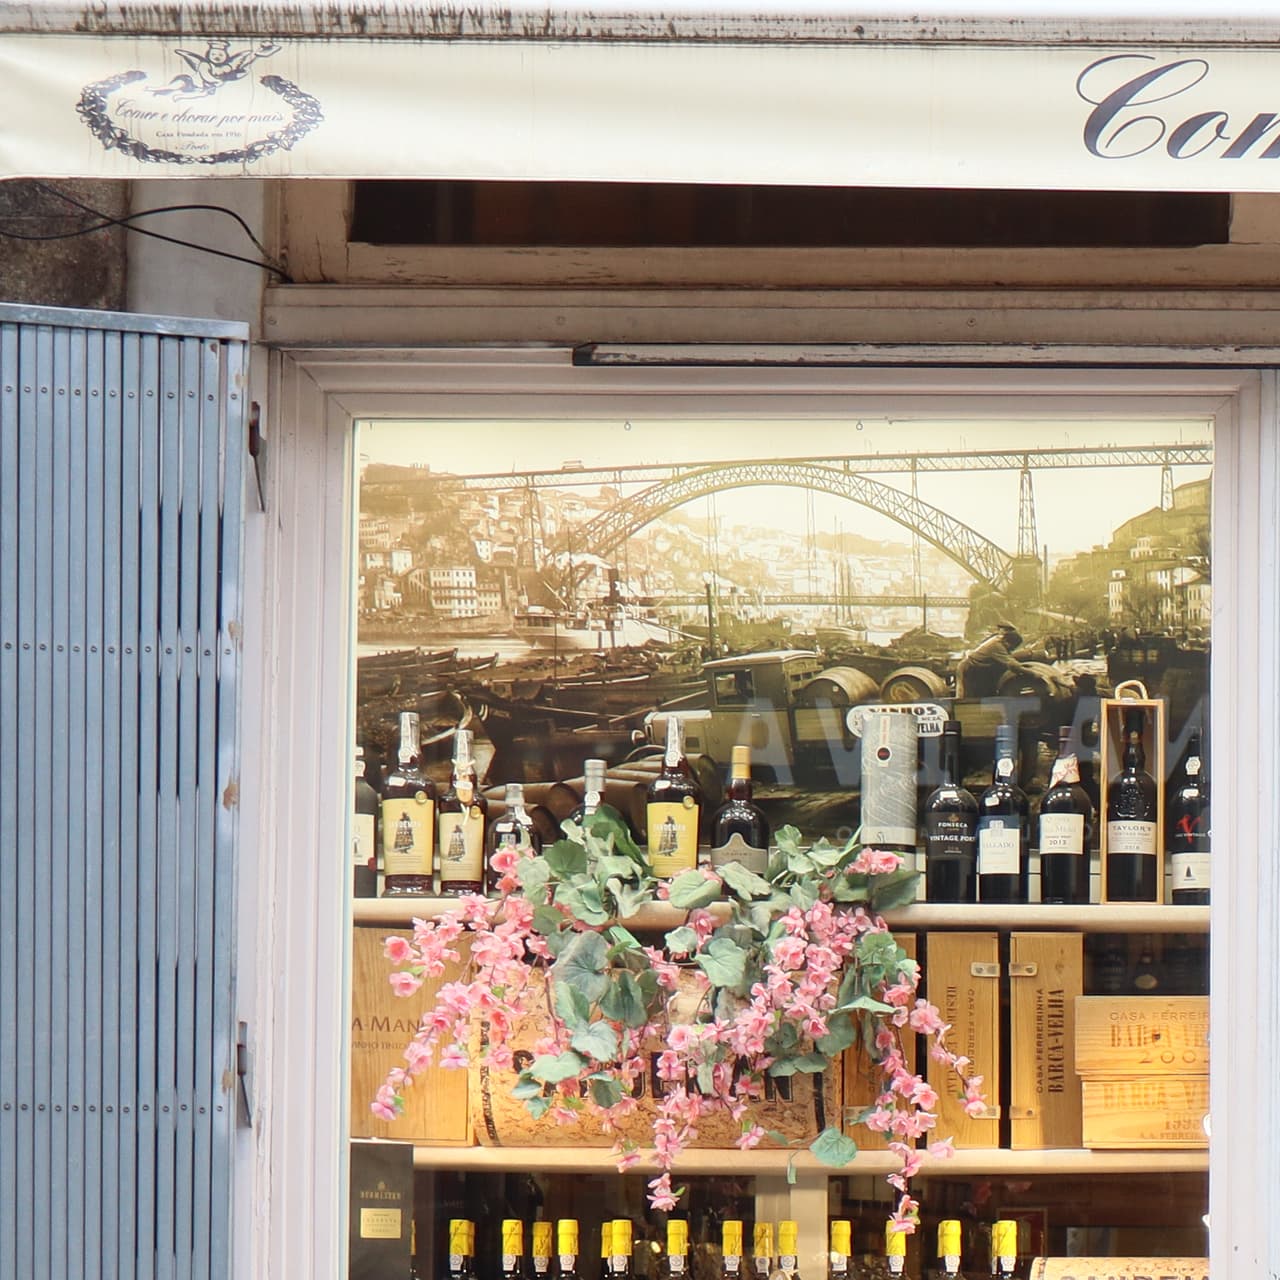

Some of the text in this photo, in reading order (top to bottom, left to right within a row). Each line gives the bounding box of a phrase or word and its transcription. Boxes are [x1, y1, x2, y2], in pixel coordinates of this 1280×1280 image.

[171, 107, 218, 123] chorar
[217, 115, 246, 127] por
[1048, 988, 1065, 1094] BARCA-VELHA
[1035, 1064, 1044, 1094] CASA
